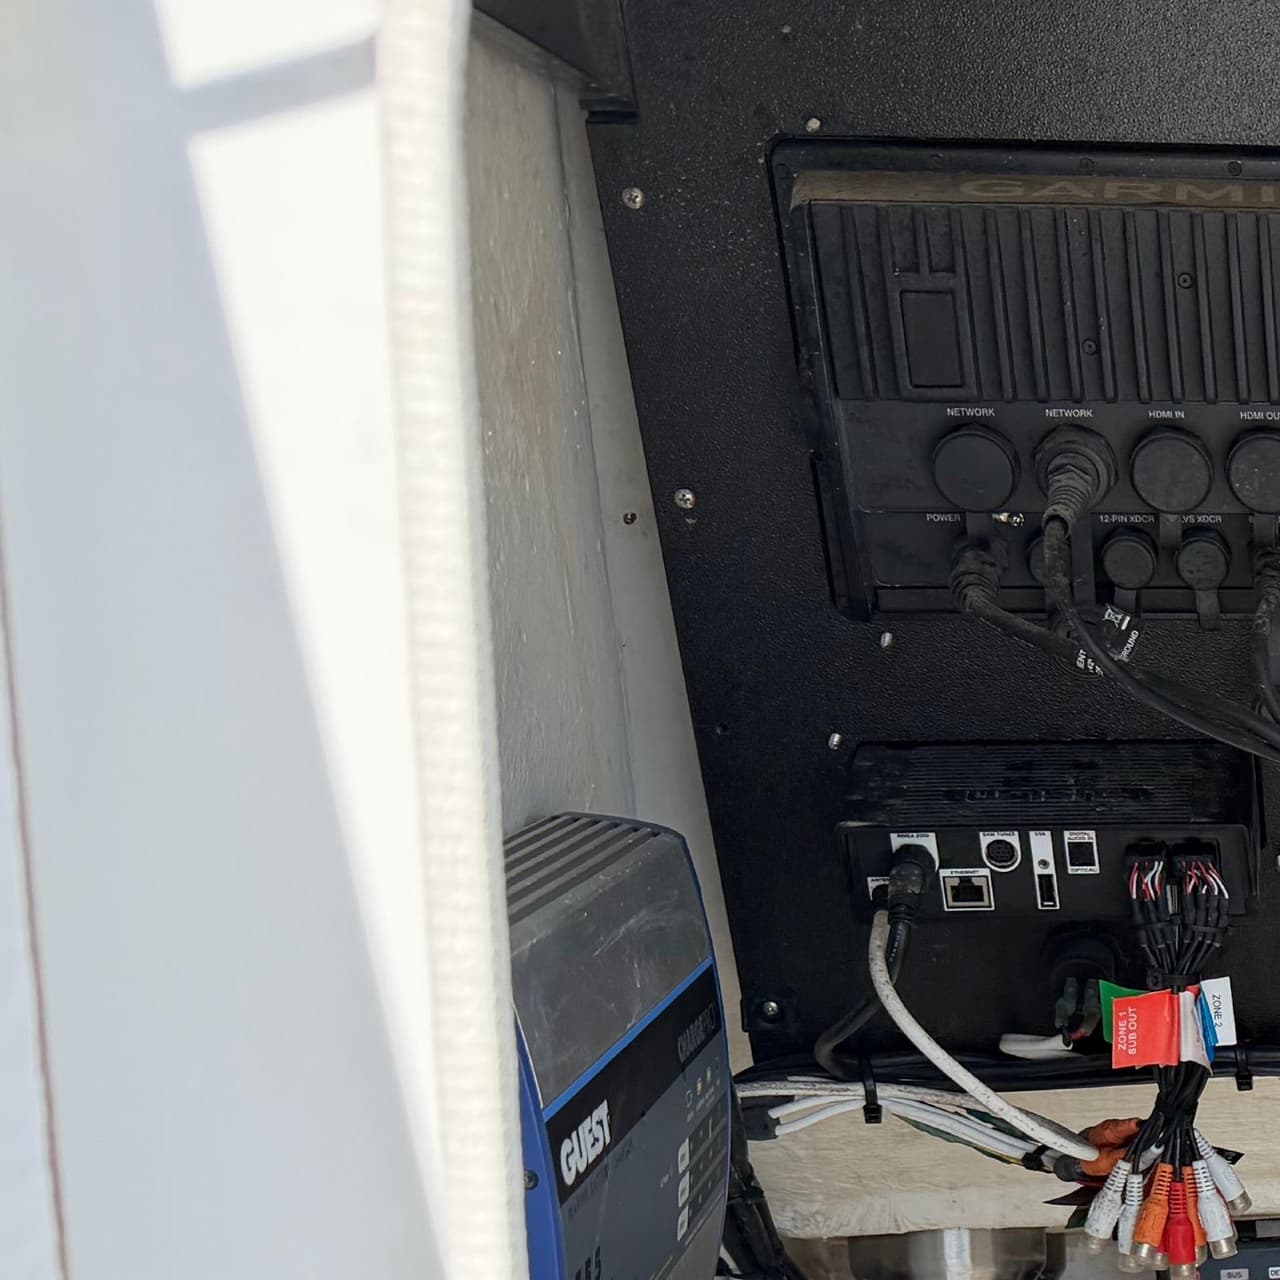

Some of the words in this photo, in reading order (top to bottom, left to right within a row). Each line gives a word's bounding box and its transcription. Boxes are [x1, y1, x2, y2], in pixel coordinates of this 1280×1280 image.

[946, 407, 996, 417] NETWORK
[1045, 408, 1094, 418] NETWORK
[1148, 410, 1173, 419] HDMI
[1174, 410, 1185, 419] IN
[1240, 411, 1264, 421] HDMI
[926, 513, 961, 522] POWER
[1099, 515, 1128, 524] 12-PIN
[1128, 515, 1155, 524] XDCR
[1197, 515, 1222, 524] XDCR
[1119, 630, 1139, 661] ROUND
[1213, 993, 1223, 1020] ZONE
[1128, 1006, 1137, 1030] OUT
[1118, 1019, 1127, 1051] ZONE
[1128, 1033, 1137, 1055] SUB
[560, 1098, 611, 1186] GUEST
[1226, 1271, 1243, 1280] BUS
